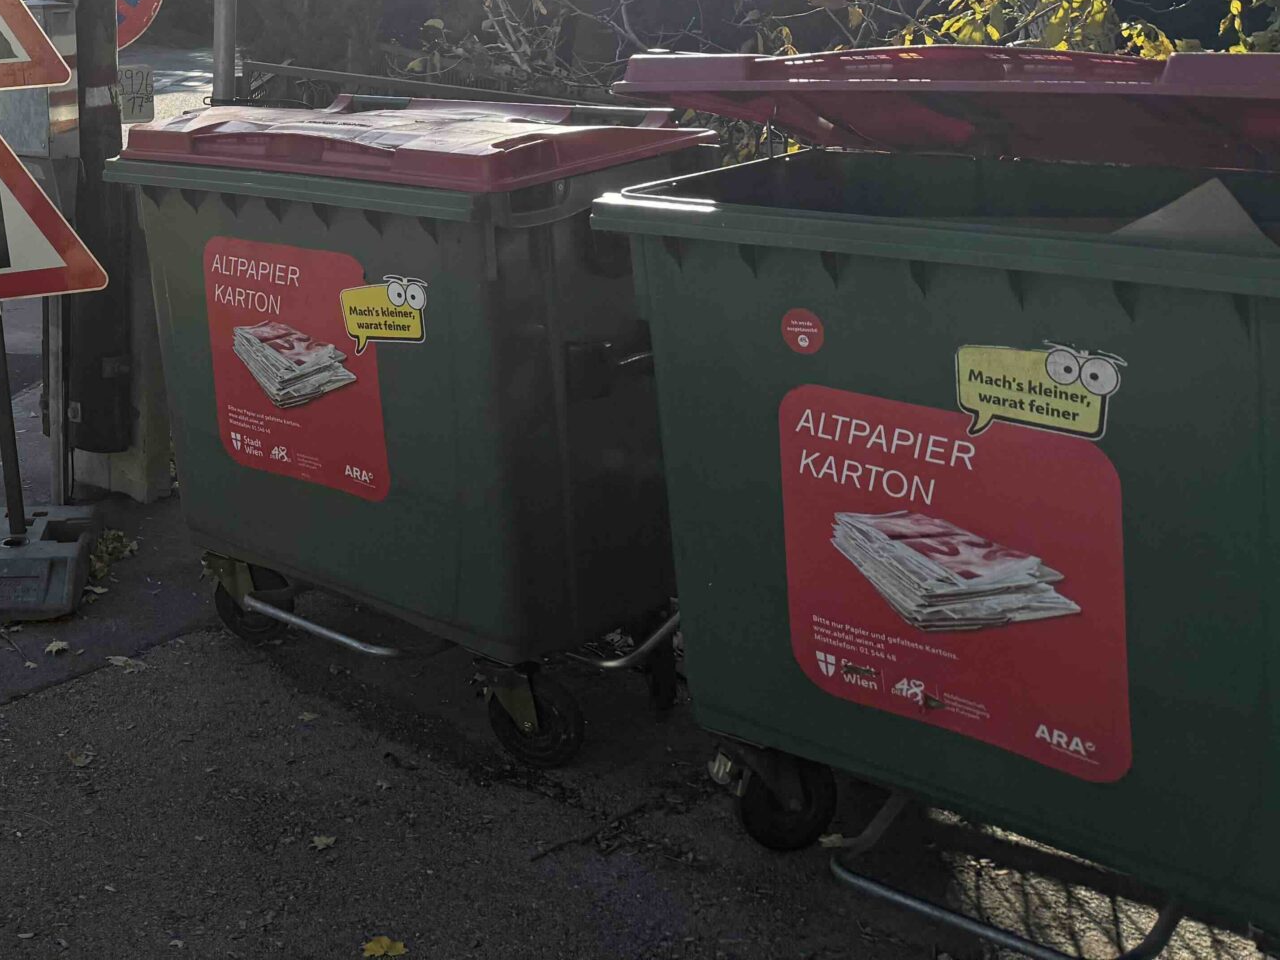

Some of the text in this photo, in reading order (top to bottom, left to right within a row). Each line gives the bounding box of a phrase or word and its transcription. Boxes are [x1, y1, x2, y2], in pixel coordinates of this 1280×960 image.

[211, 253, 300, 287] ALTPAPIER
[214, 283, 281, 315] KARTON
[349, 305, 416, 320] Mach's kleiner,
[356, 320, 411, 332] warat feiner
[967, 368, 1092, 408] Mach's kleiner,
[978, 392, 1080, 422] warat feiner
[243, 435, 262, 448] Stadt
[244, 444, 264, 457] Wien
[795, 408, 976, 471] ALTPAPIER
[344, 464, 370, 483] ARA
[798, 448, 936, 506] KARTON
[812, 614, 831, 626] Bitte
[831, 621, 844, 630] nur
[845, 624, 869, 637] Papier
[870, 631, 886, 641] und
[887, 636, 924, 651] gefaltete
[843, 673, 878, 690] Wien
[1034, 724, 1087, 756] ARA
